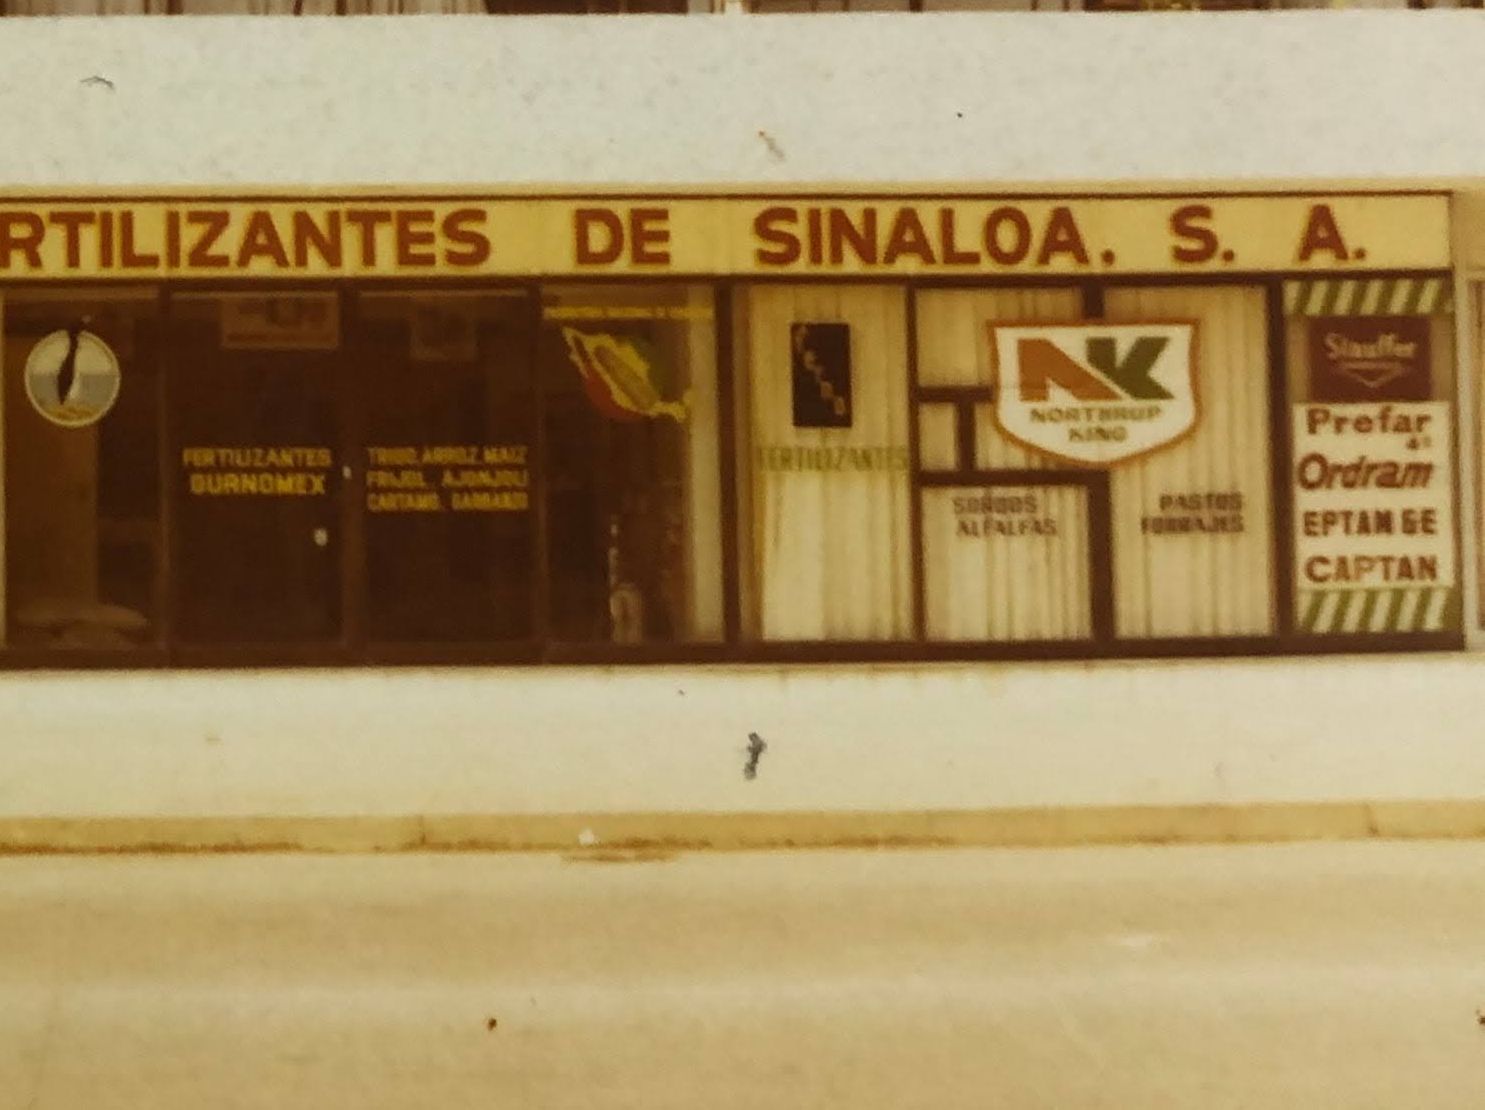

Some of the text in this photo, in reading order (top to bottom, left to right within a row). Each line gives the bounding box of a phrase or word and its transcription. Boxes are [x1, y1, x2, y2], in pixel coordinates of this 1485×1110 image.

[575, 209, 670, 267] DE
[754, 207, 1115, 265] SINALOA.
[1169, 206, 1235, 263] S.
[1298, 204, 1366, 261] A.
[1017, 337, 1174, 401] NK
[1030, 406, 1162, 423] NORTHRUP
[1307, 406, 1432, 434] Prefar
[1068, 426, 1127, 442] KING
[183, 448, 331, 467] FERTILIZANTES
[1298, 453, 1433, 489] Ordram
[1159, 493, 1243, 510] PASTOS
[956, 517, 1057, 536] ALFALFAS
[1304, 509, 1393, 536] EPTAM
[1305, 555, 1437, 582] CAPTAN
